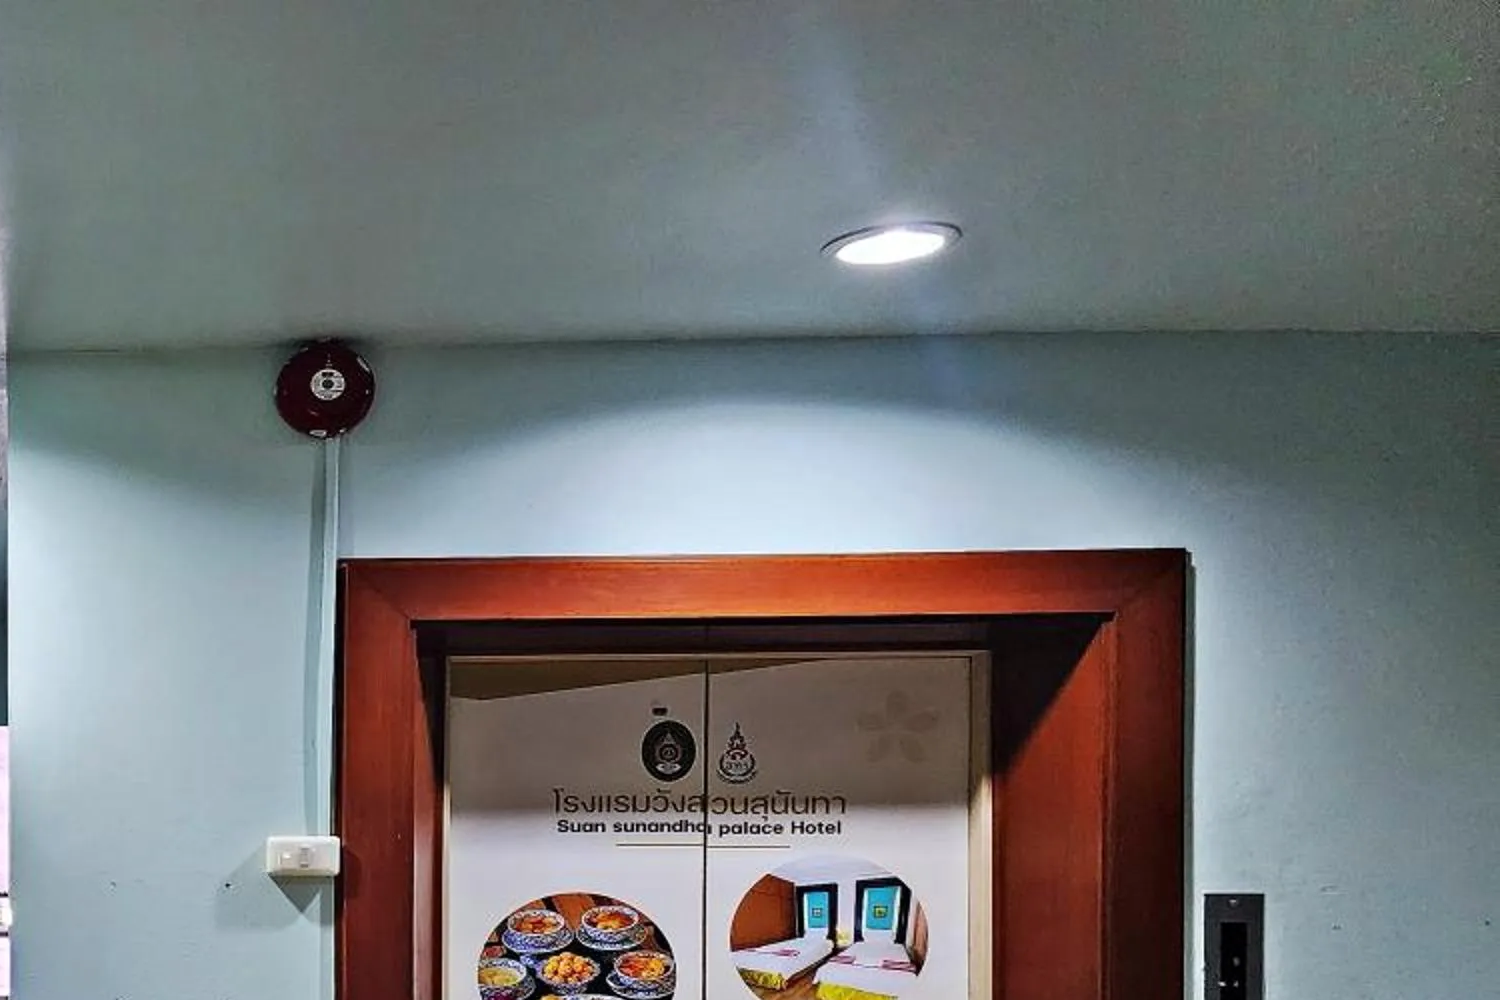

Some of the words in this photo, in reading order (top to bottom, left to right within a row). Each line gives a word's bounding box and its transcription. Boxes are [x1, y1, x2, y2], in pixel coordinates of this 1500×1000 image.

[553, 787, 847, 821] โรงแรมวังสวนสุนันทา
[557, 819, 606, 833] Suan
[613, 819, 712, 835] sunandha
[719, 822, 784, 838] palace
[791, 821, 842, 835] Hotel
